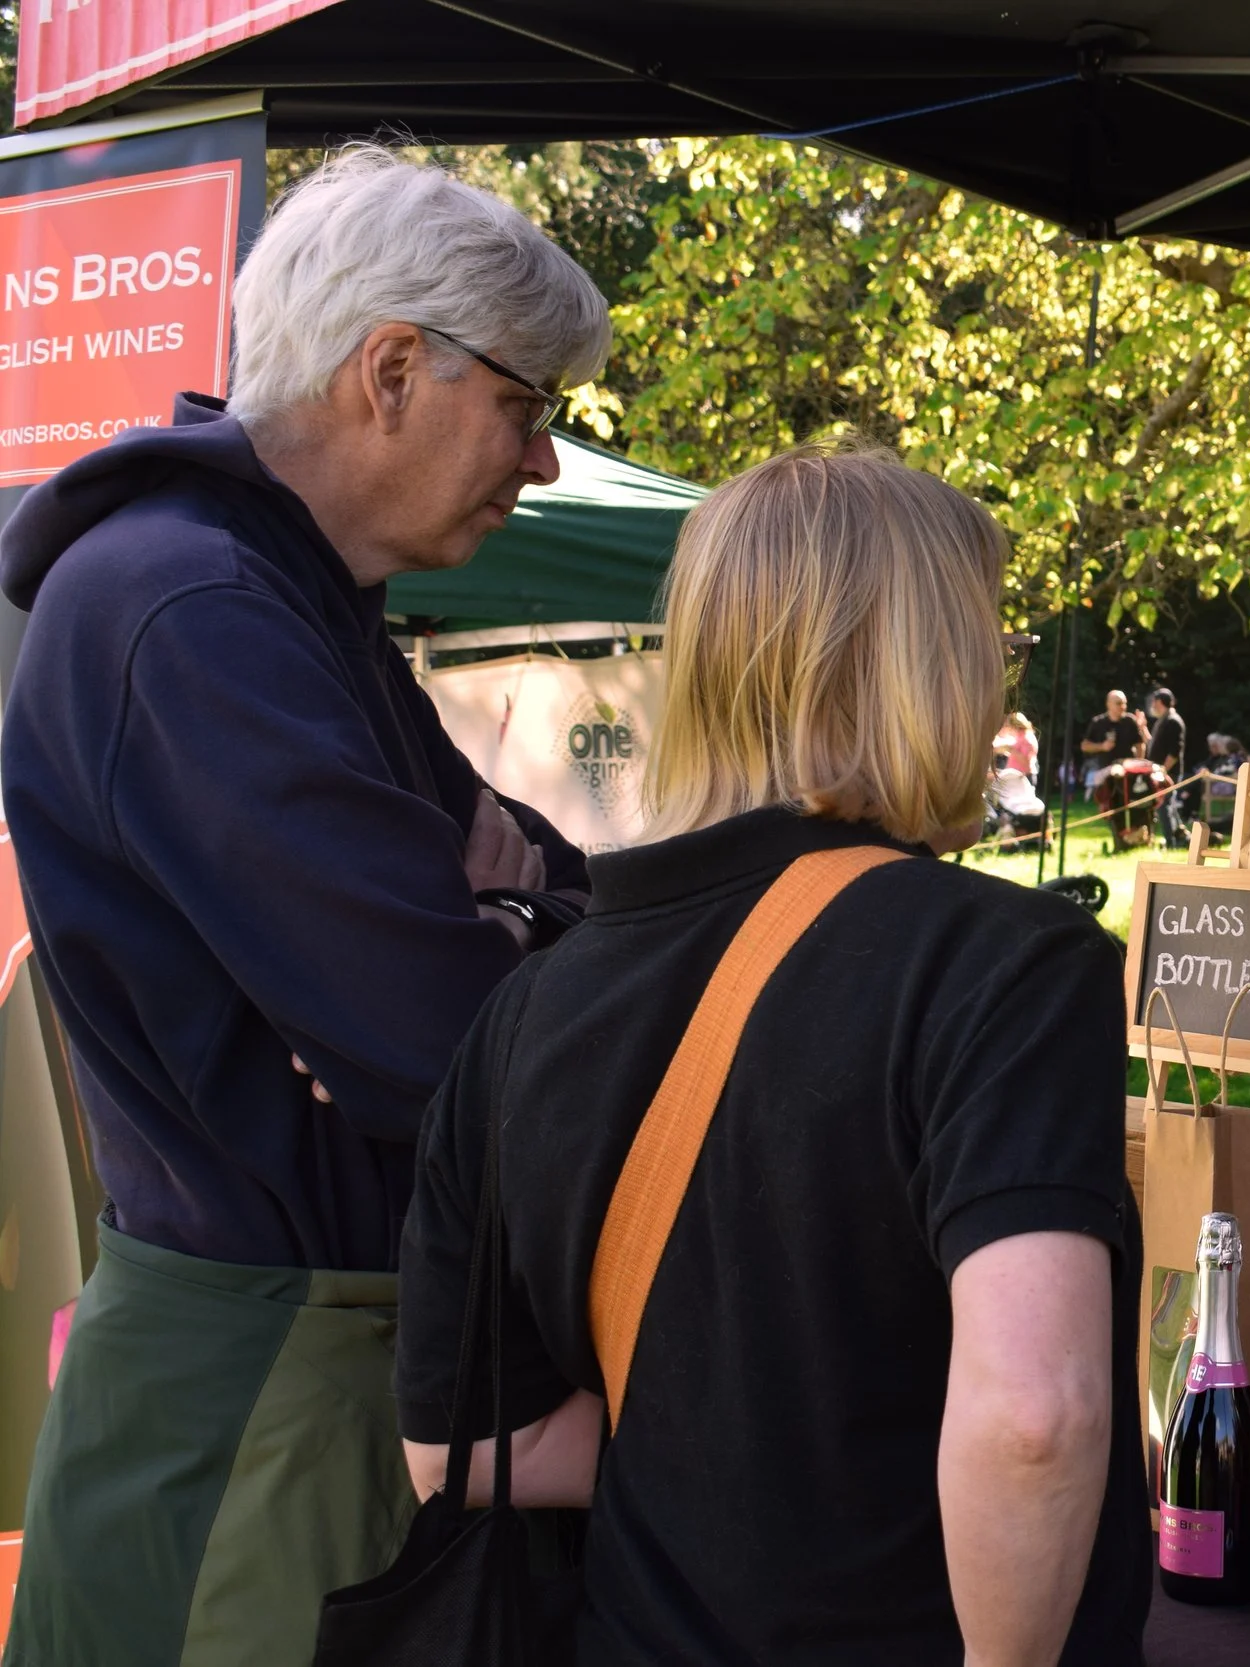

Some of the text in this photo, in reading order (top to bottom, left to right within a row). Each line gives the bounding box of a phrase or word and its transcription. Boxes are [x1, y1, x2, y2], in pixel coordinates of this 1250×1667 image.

[72, 246, 213, 302] BROS.
[84, 322, 184, 360] WINES
[569, 723, 632, 758] one
[1158, 903, 1245, 937] GLASS
